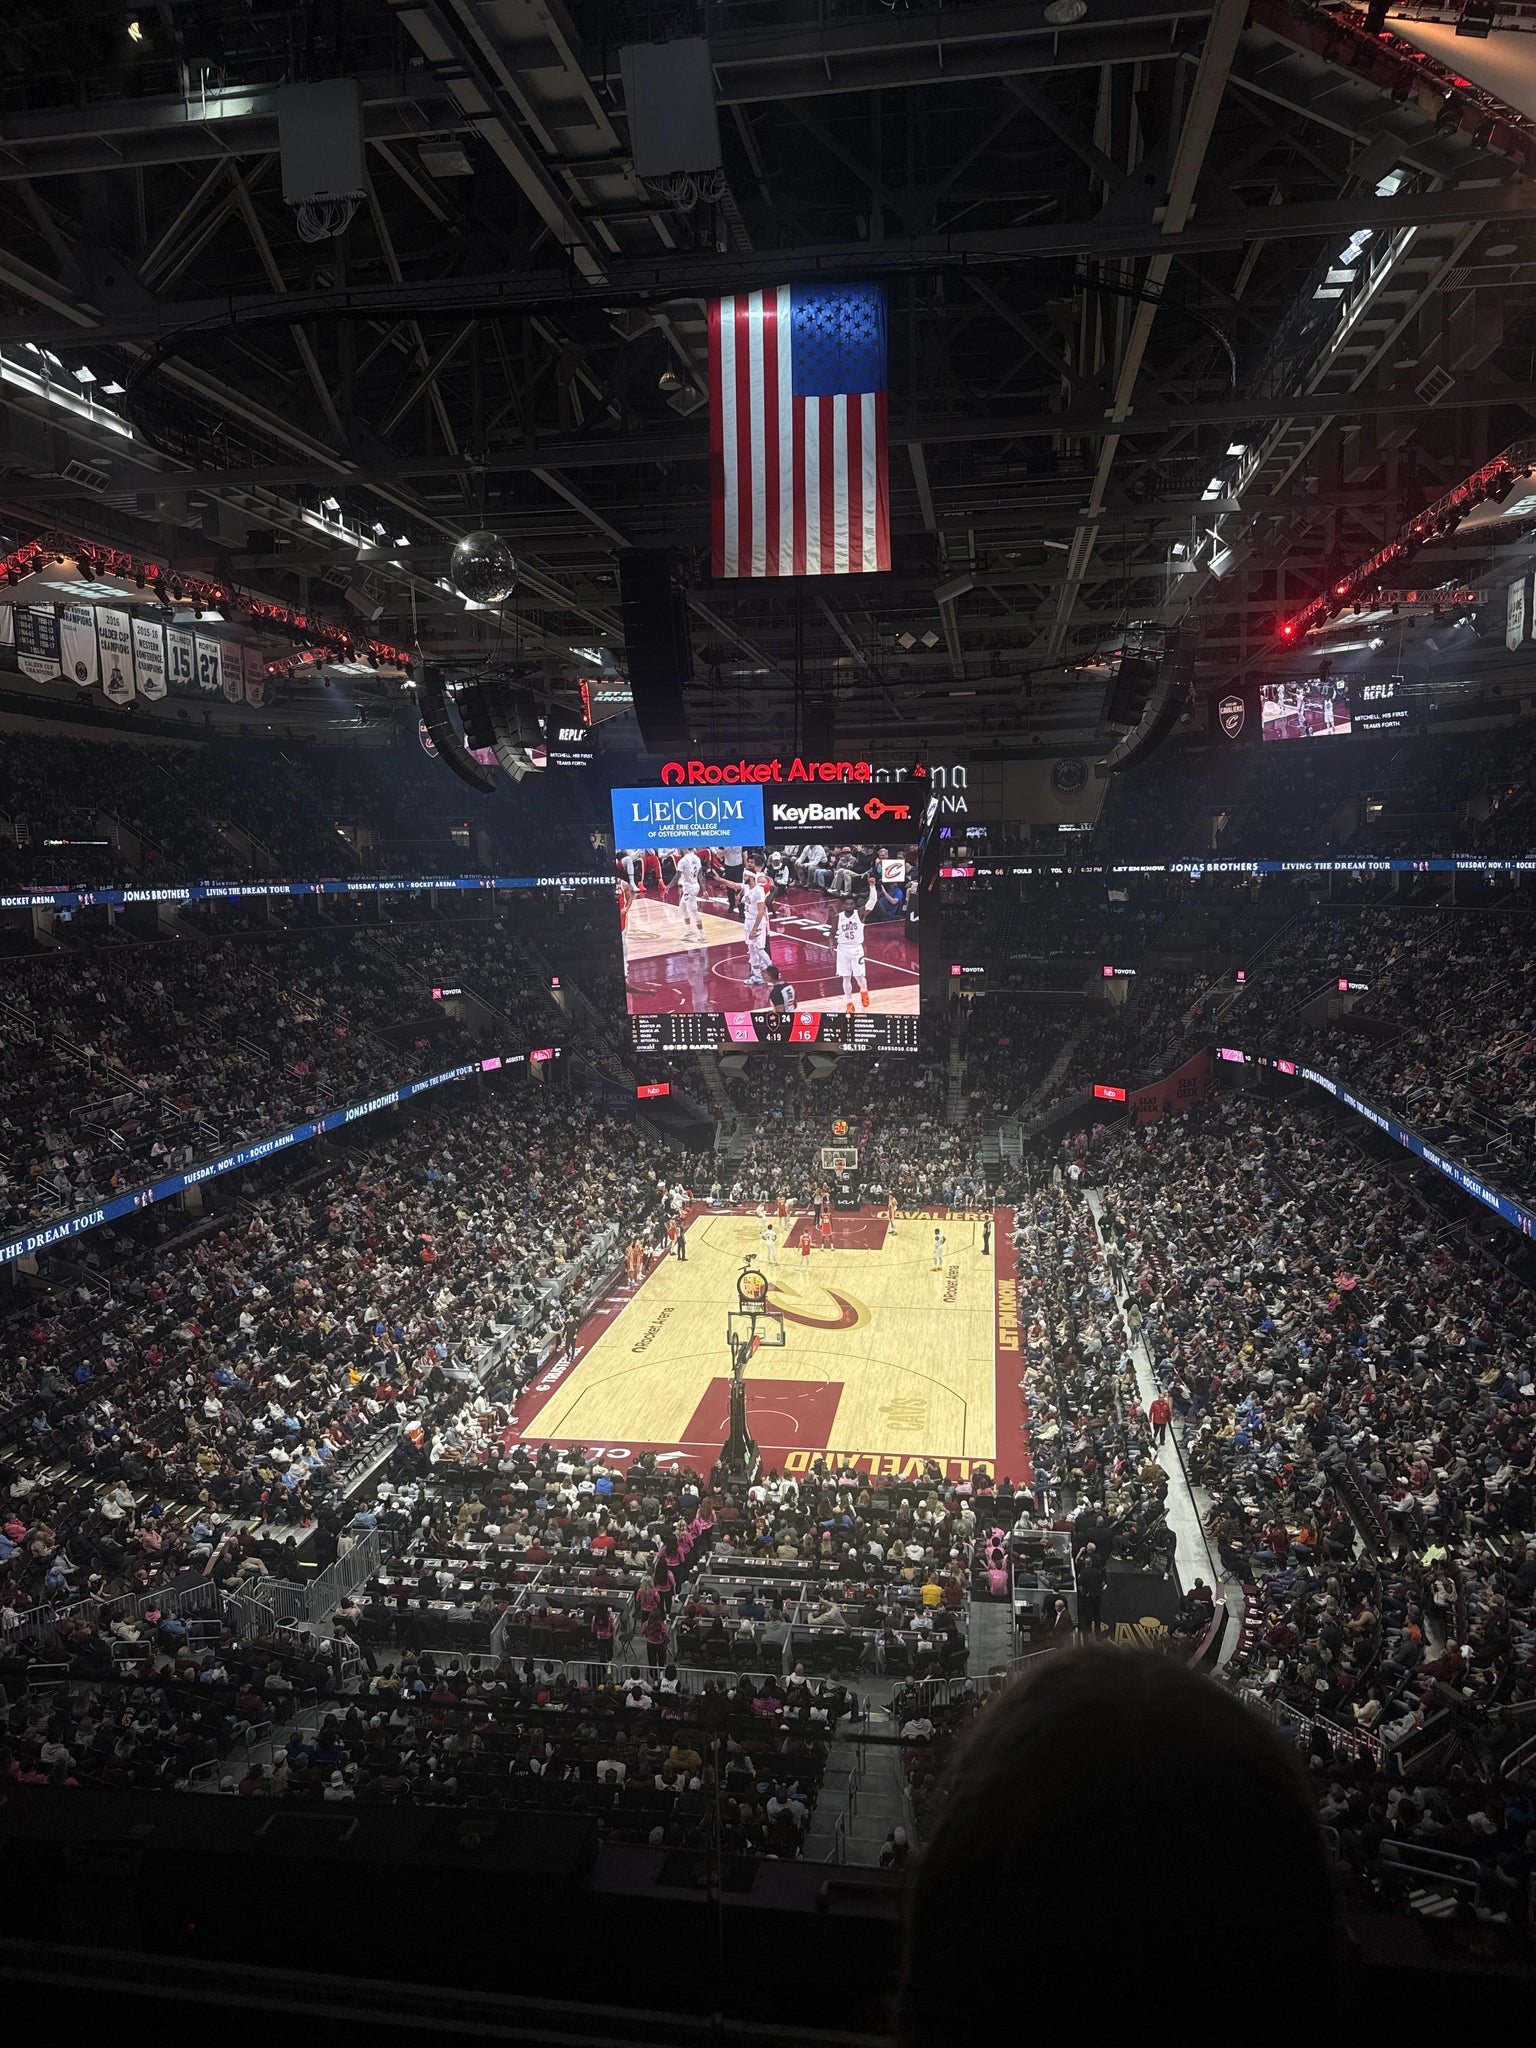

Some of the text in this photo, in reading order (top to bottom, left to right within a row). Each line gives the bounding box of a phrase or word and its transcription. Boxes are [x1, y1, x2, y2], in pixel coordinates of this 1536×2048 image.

[106, 614, 120, 626] 2016
[100, 627, 129, 642] CALDER CUP
[137, 626, 158, 639] 2015-16
[101, 640, 130, 654] CHAMPIONS
[138, 640, 159, 652] WESTERN
[137, 650, 162, 663] CONFERENCE
[172, 646, 190, 678] 15
[138, 661, 162, 674] CHAMPIONS
[200, 654, 218, 684] 27
[687, 758, 871, 784] Rocket Arena
[772, 803, 860, 824] KeyBank
[1170, 863, 1204, 872] JONAS
[1206, 862, 1258, 871] BROTHERS
[1, 896, 30, 906] ROCKET
[32, 896, 55, 904] ARENA
[123, 890, 150, 902] JONAS
[152, 889, 190, 900] BROTHERS
[206, 888, 228, 896] LIVING
[242, 886, 267, 894] DREAM
[536, 878, 565, 886] JONAS
[844, 932, 854, 940] 45
[735, 1030, 748, 1040] 21
[798, 1030, 811, 1040] 16
[506, 1055, 524, 1063] ASSISTS
[1302, 1068, 1320, 1083] JONAS
[0, 1242, 24, 1261] THE
[27, 1223, 70, 1250] DREAM
[73, 1210, 104, 1231] TOUR
[184, 1164, 216, 1184] TUESDAY,
[218, 1157, 235, 1171] NOV.
[250, 1142, 274, 1157] ROCKET
[274, 1134, 294, 1148] ARENA
[346, 1104, 368, 1121] JONAS
[369, 1091, 398, 1112] BROTHERS
[412, 1080, 429, 1093] LIVING
[430, 1076, 438, 1086] THE
[440, 1070, 455, 1082] DREAM
[456, 1066, 472, 1076] TOUR
[1442, 1160, 1453, 1175] NOV.
[1463, 1175, 1481, 1194] ROCKET
[1482, 1189, 1499, 1208] ARENA
[944, 1265, 959, 1298] Rocket Arena
[999, 1312, 1017, 1328] EM
[636, 1308, 675, 1349] Rocket Arena
[999, 1328, 1019, 1351] LET
